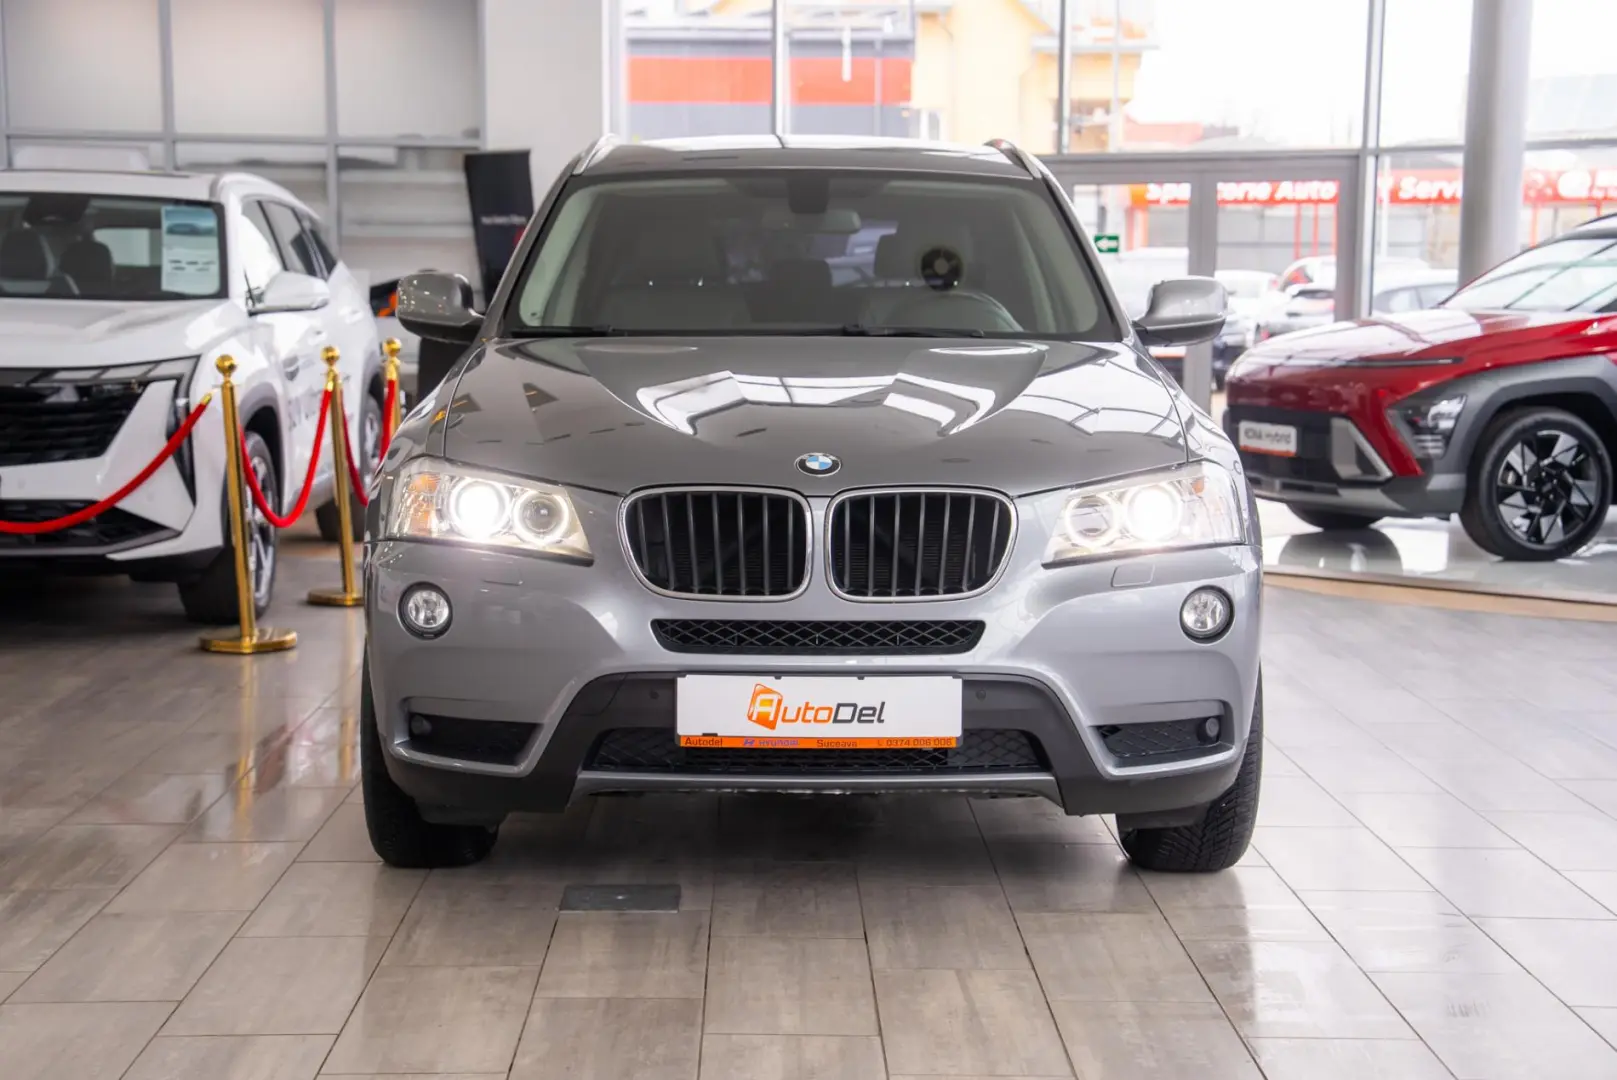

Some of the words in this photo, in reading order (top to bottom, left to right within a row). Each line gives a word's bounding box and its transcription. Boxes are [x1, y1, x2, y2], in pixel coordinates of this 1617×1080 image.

[747, 683, 886, 730] AutoDel
[684, 736, 723, 746] Autodel
[816, 739, 858, 748] Suceava
[886, 738, 910, 747] 0374
